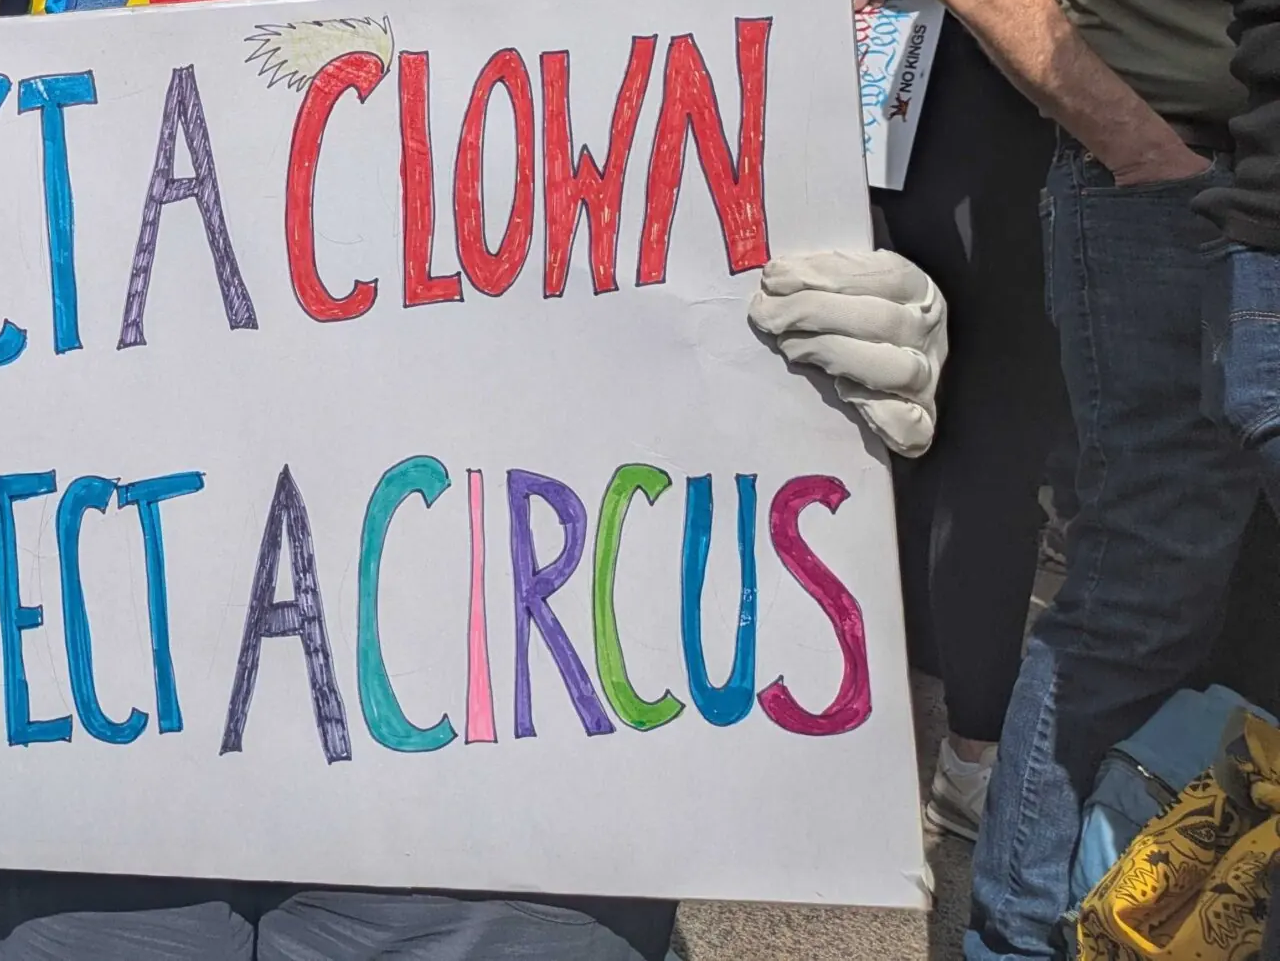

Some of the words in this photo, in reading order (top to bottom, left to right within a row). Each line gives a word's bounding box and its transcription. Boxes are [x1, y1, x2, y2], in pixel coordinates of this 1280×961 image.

[899, 70, 915, 93] NO
[906, 24, 927, 70] KINGS
[116, 64, 259, 351] A
[285, 16, 774, 324] CLOWN
[219, 463, 353, 765] A
[356, 454, 874, 753] CIRCUS
